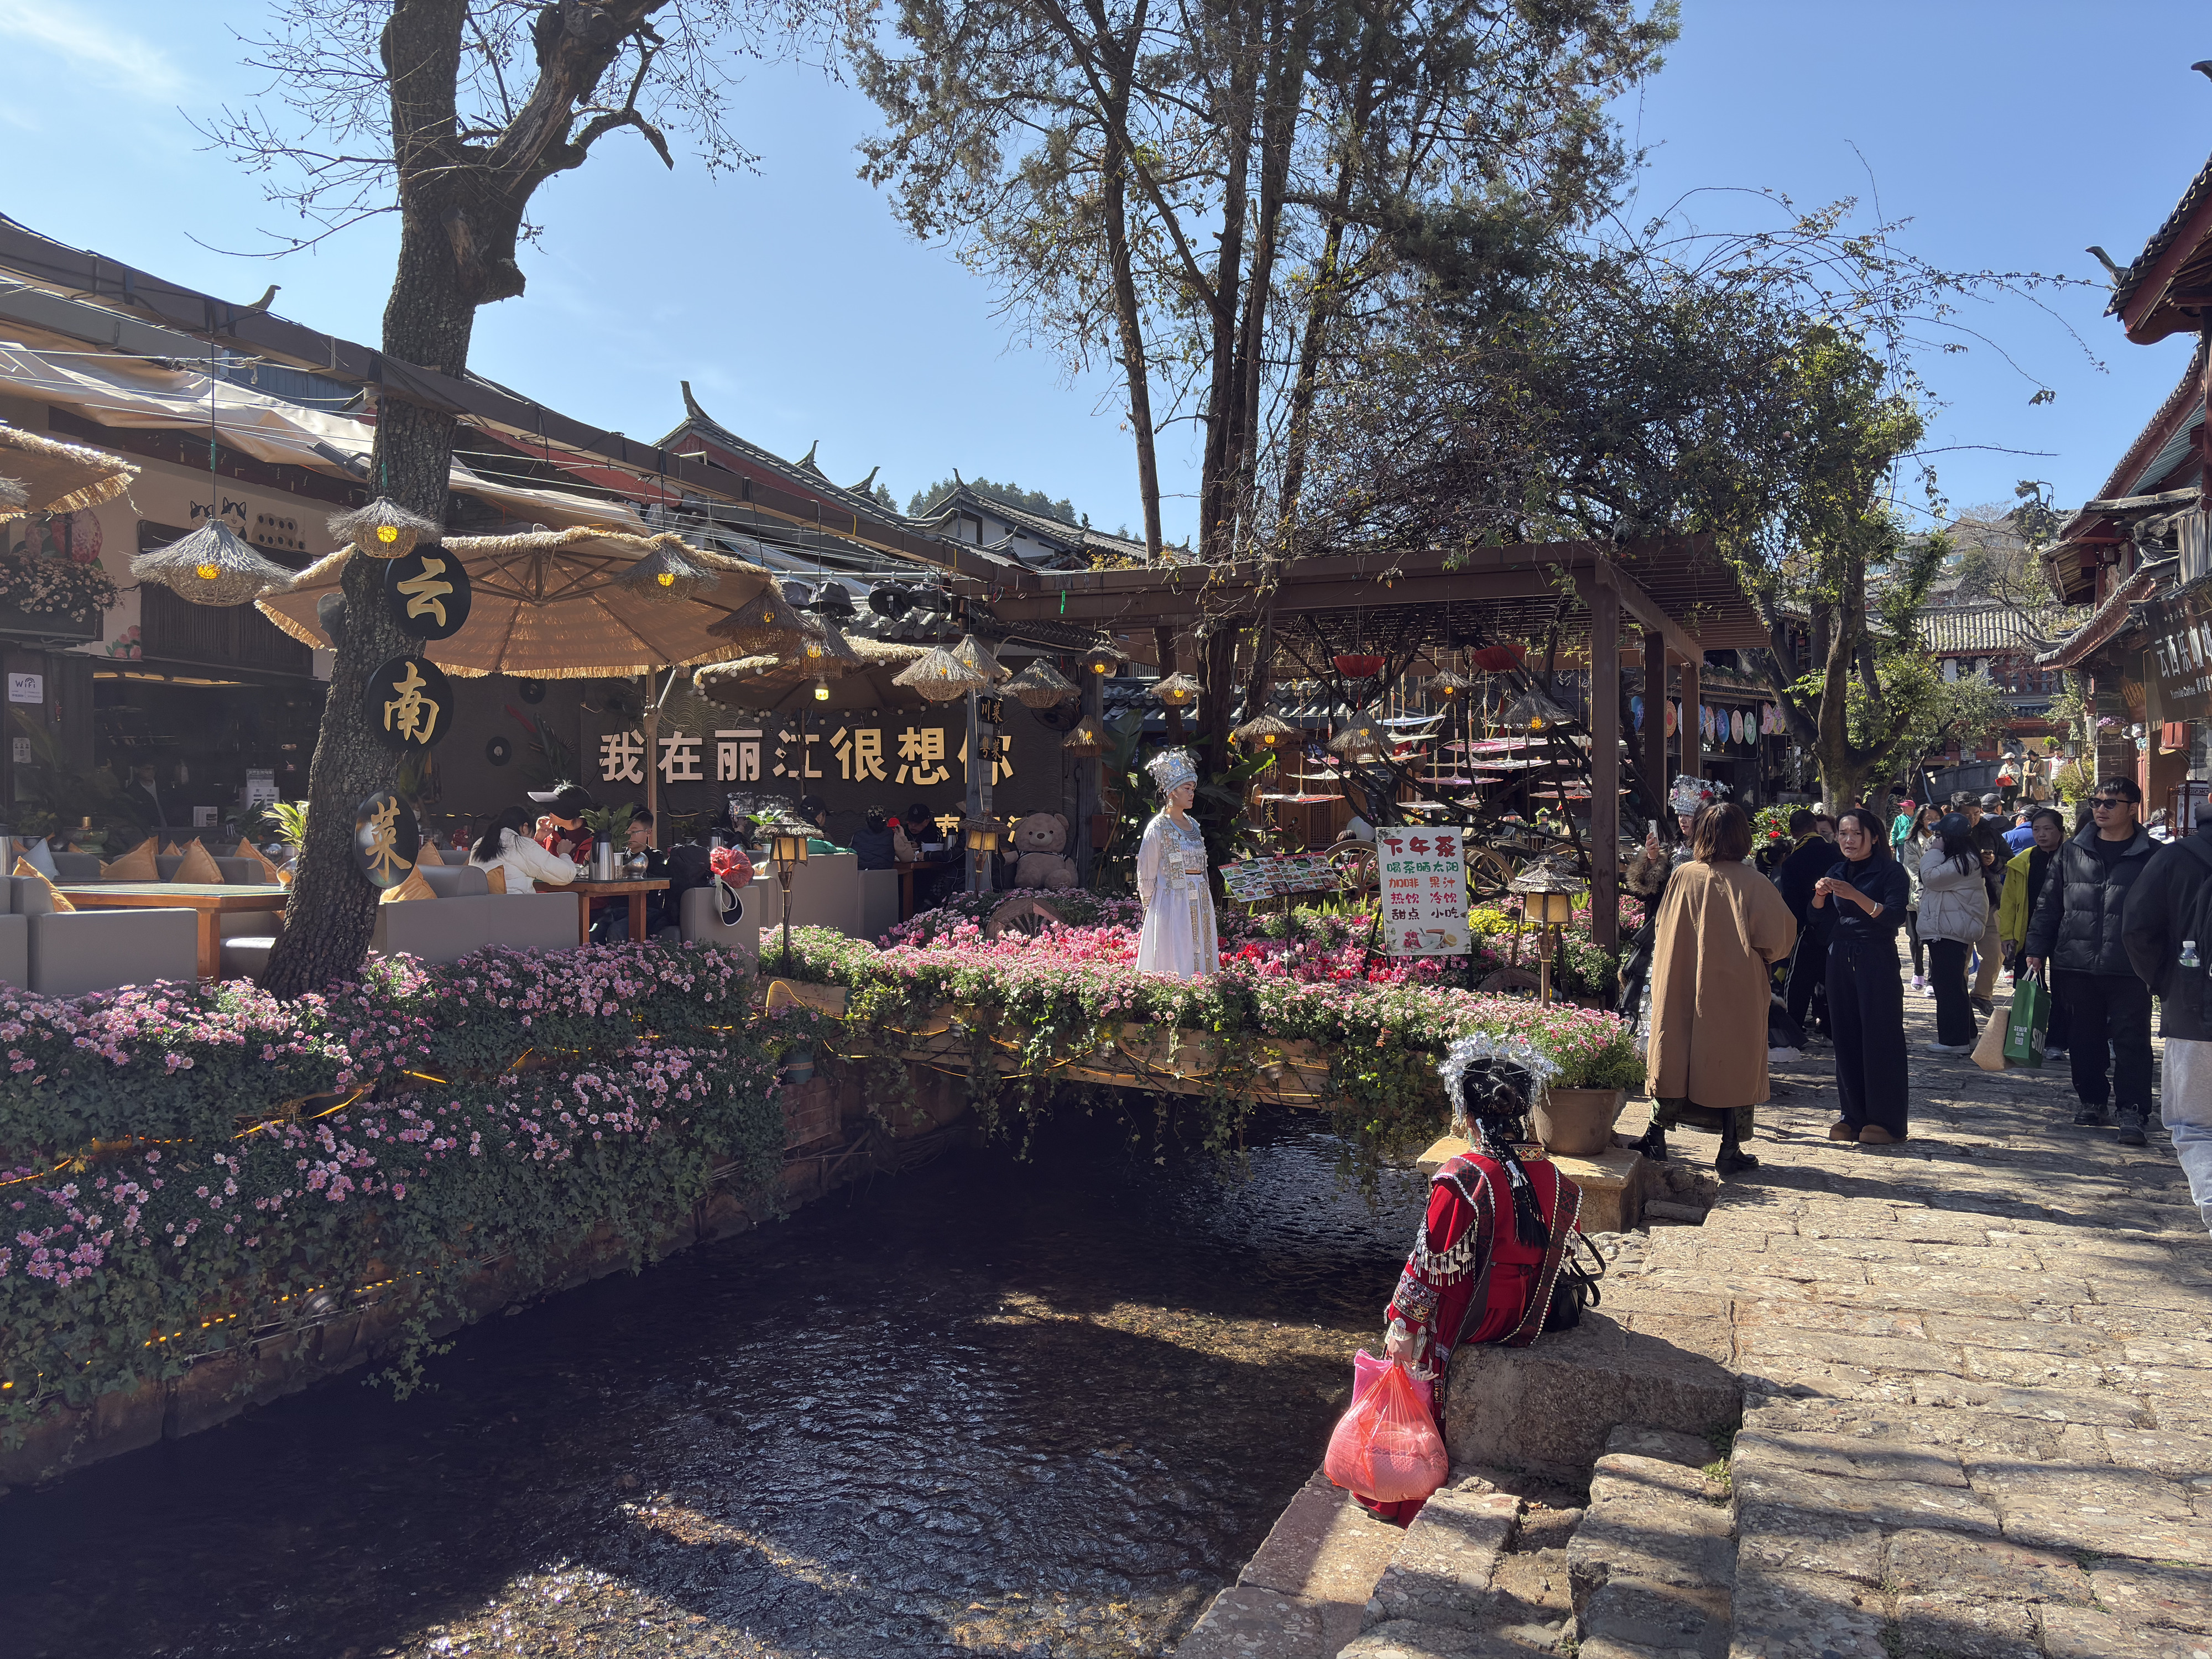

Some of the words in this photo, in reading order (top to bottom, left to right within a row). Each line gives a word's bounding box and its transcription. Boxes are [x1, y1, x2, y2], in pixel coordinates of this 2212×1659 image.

[2183, 685, 2195, 696] Coffee
[982, 699, 1003, 724] 川菜
[979, 735, 1002, 761] 粤菜
[599, 726, 1014, 785] 我在丽江很想你
[1383, 836, 1457, 858] 下午茶
[1386, 860, 1459, 874] 喝茶晒太阳
[1429, 877, 1455, 889] 果汁
[1390, 891, 1420, 905] 热饮
[1430, 891, 1457, 905] 冷饮
[1391, 907, 1420, 920] 甜点
[1431, 906, 1459, 919] 小吃
